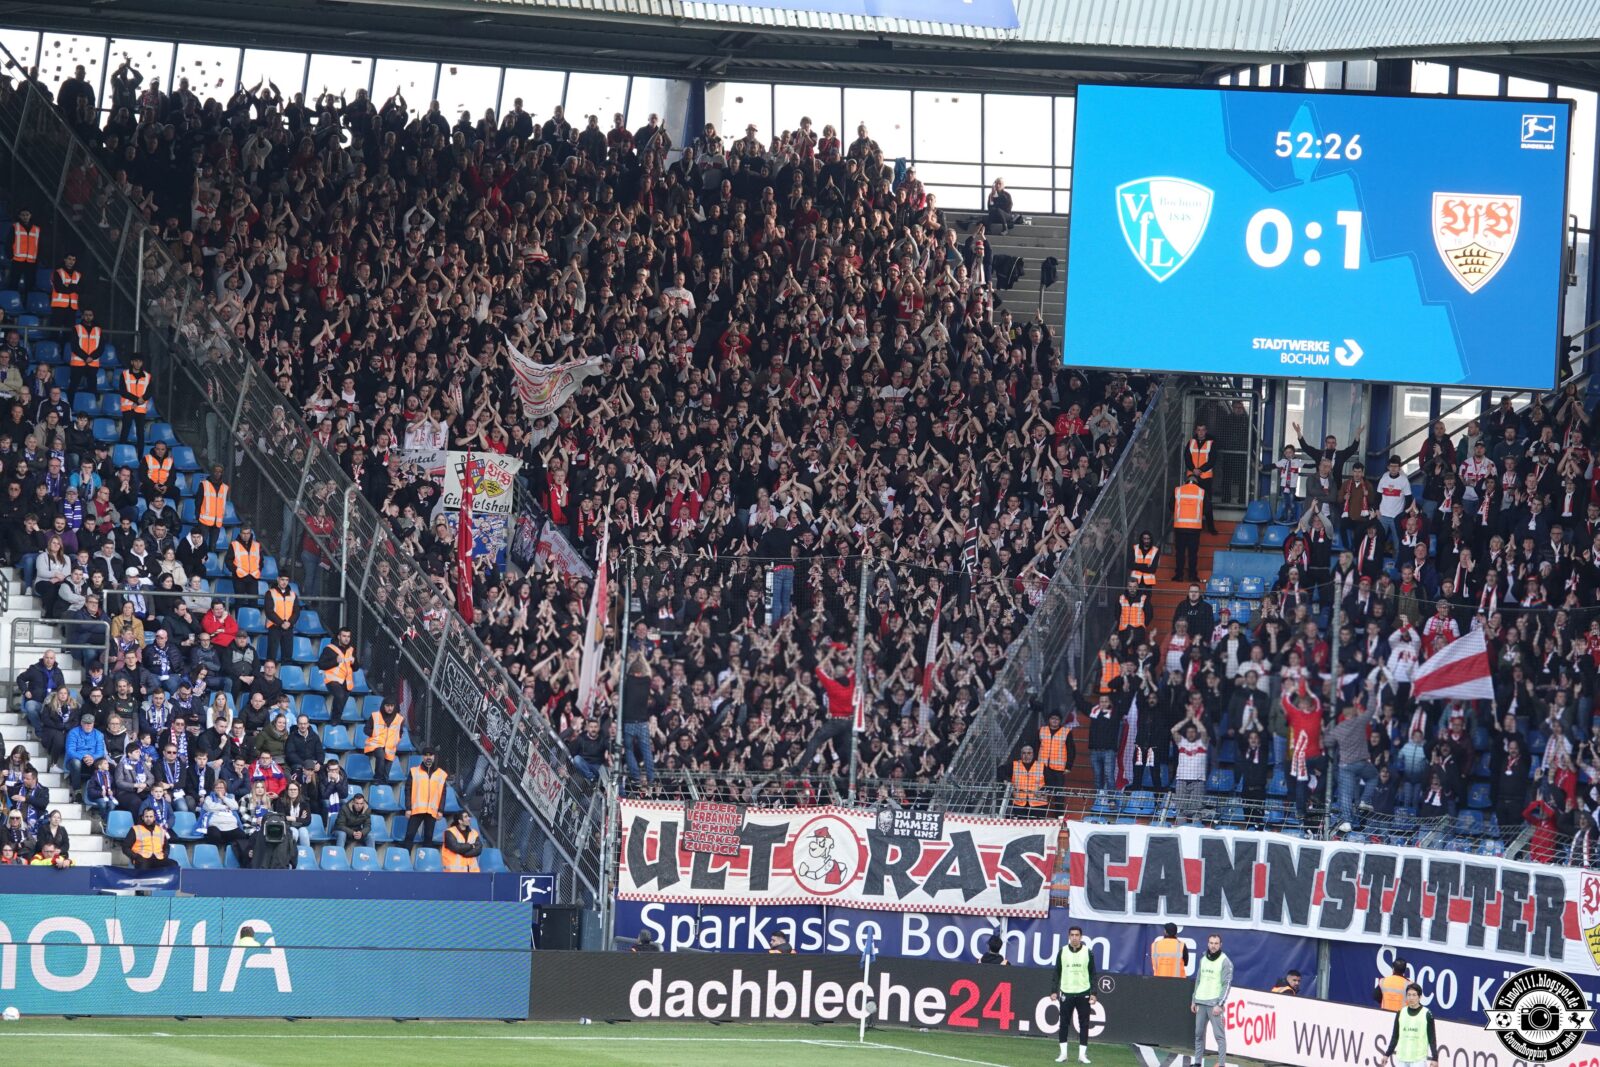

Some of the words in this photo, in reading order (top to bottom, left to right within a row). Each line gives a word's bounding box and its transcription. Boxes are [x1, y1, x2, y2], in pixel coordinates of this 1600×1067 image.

[1275, 131, 1363, 160] 52:26
[1121, 193, 1175, 267] VfL
[1245, 208, 1363, 270] 0:1
[1252, 338, 1330, 353] STADTWERKE
[1280, 353, 1330, 366] BOCHUM
[694, 801, 737, 814] JEDER
[687, 808, 743, 826] VERBANNTE
[895, 810, 911, 819] DU
[915, 812, 940, 822] BIST
[691, 821, 737, 835] KEHRT
[894, 819, 939, 831] IMMER
[893, 828, 911, 836] BEI
[914, 830, 939, 839] UNS!
[1085, 831, 1566, 962] CANNSTATTER
[640, 903, 882, 953] Sparkasse
[902, 911, 1110, 970] Bochum
[1244, 1011, 1277, 1046] COM
